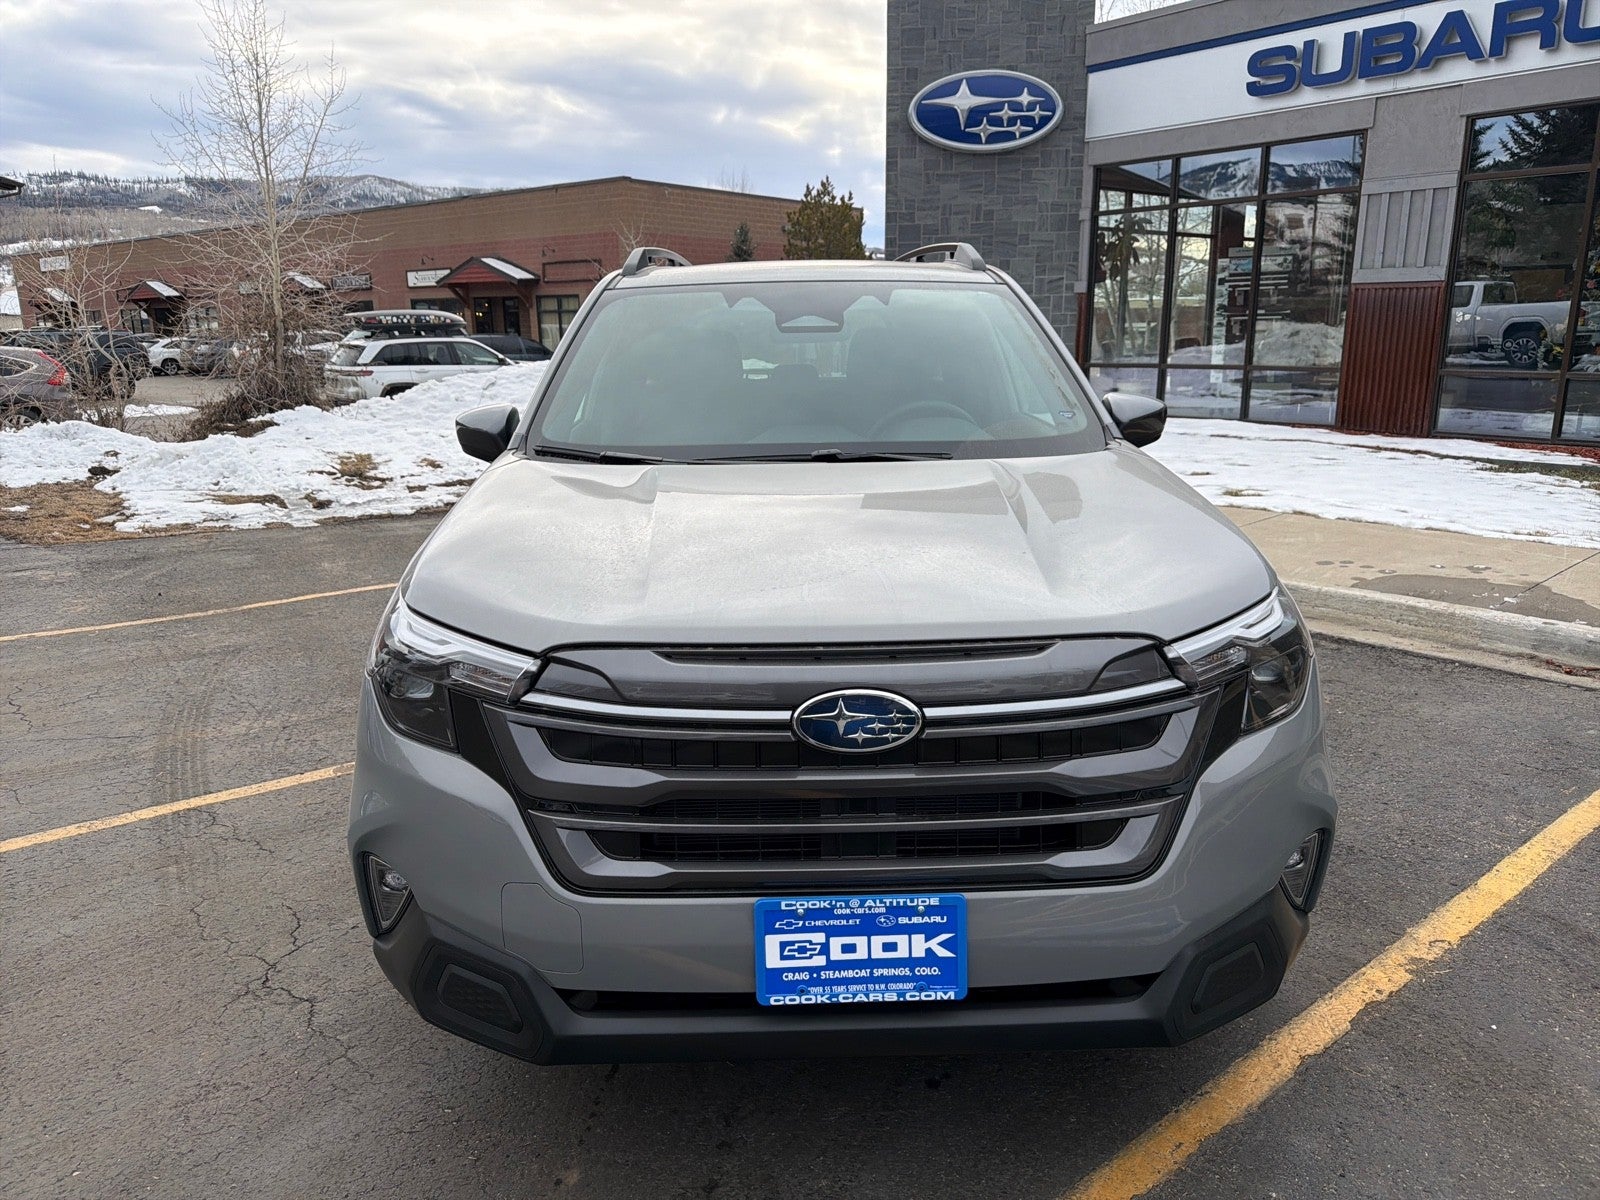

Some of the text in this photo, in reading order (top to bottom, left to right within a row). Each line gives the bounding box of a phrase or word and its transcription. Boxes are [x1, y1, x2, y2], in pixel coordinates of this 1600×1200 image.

[849, 898, 860, 908] @
[863, 897, 940, 907] ALTITUDE
[833, 907, 887, 915] cook-cars.com
[805, 919, 861, 927] CHEVROLET
[897, 915, 947, 924] SUBARU
[765, 932, 957, 969] COOK
[782, 966, 942, 981] CRAIG STEAMBOAT SPRINGS, COLO.
[824, 986, 831, 994] 55
[832, 985, 847, 993] YEARS
[847, 984, 867, 992] SERVICE
[868, 983, 874, 992] TO
[875, 983, 887, 991] N.W.
[769, 990, 956, 1006] COOK-CARS.COM
